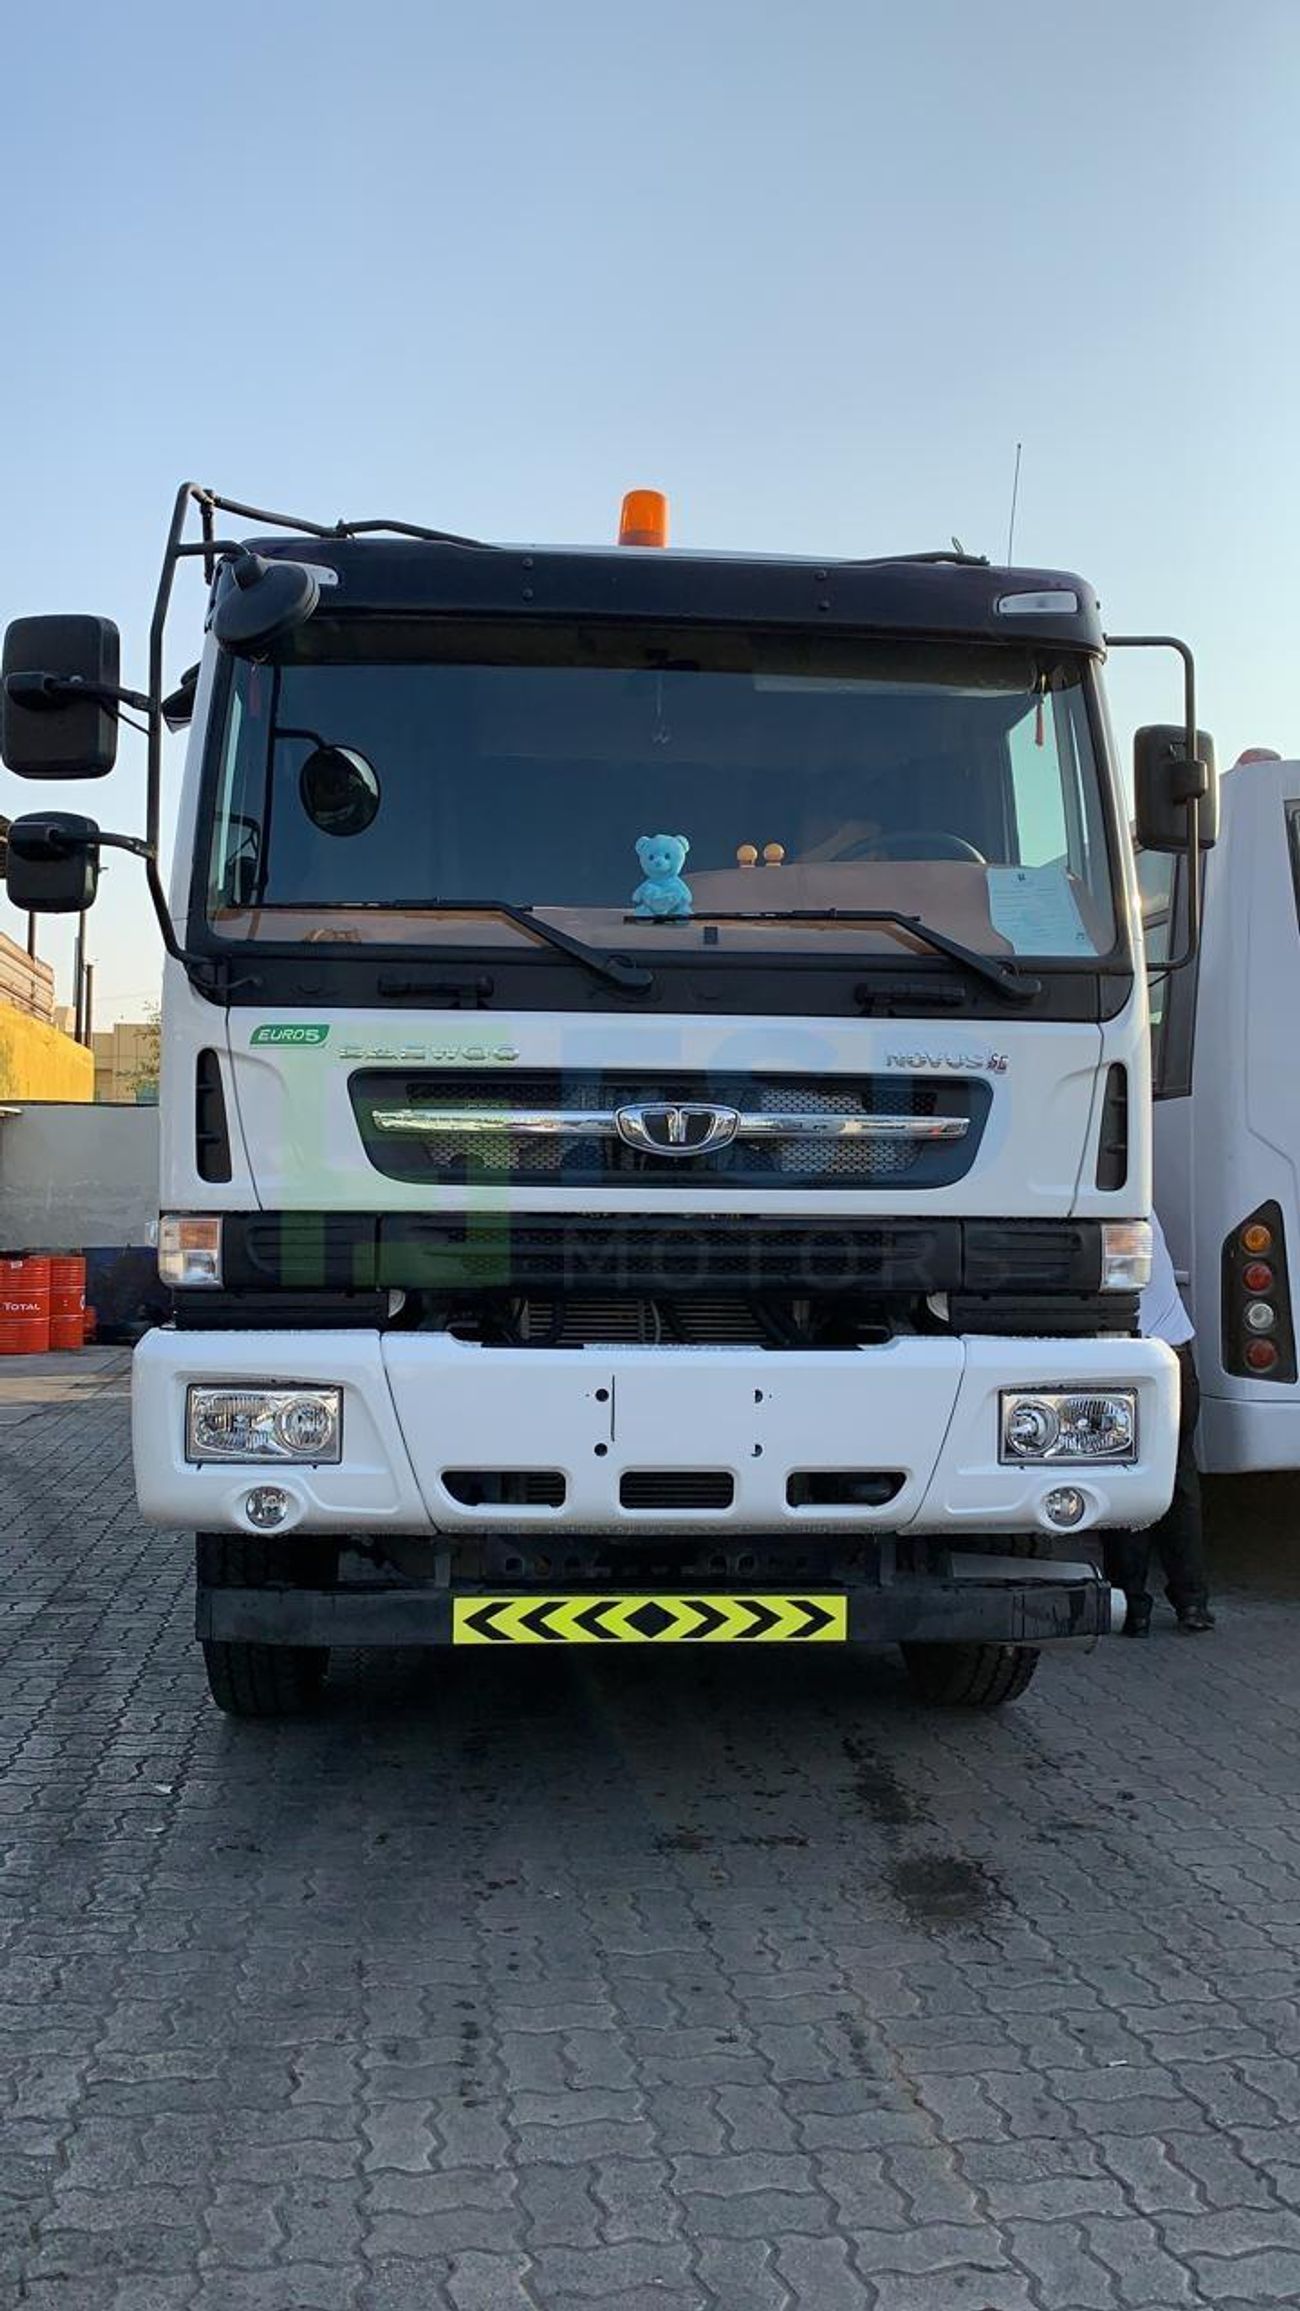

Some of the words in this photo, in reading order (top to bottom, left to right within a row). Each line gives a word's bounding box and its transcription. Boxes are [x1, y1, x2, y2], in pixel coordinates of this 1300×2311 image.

[257, 1029, 321, 1043] EURO5
[338, 1045, 520, 1061] DAEWOO
[886, 1052, 983, 1069] NOVUS
[2, 1302, 41, 1312] TOTAL
